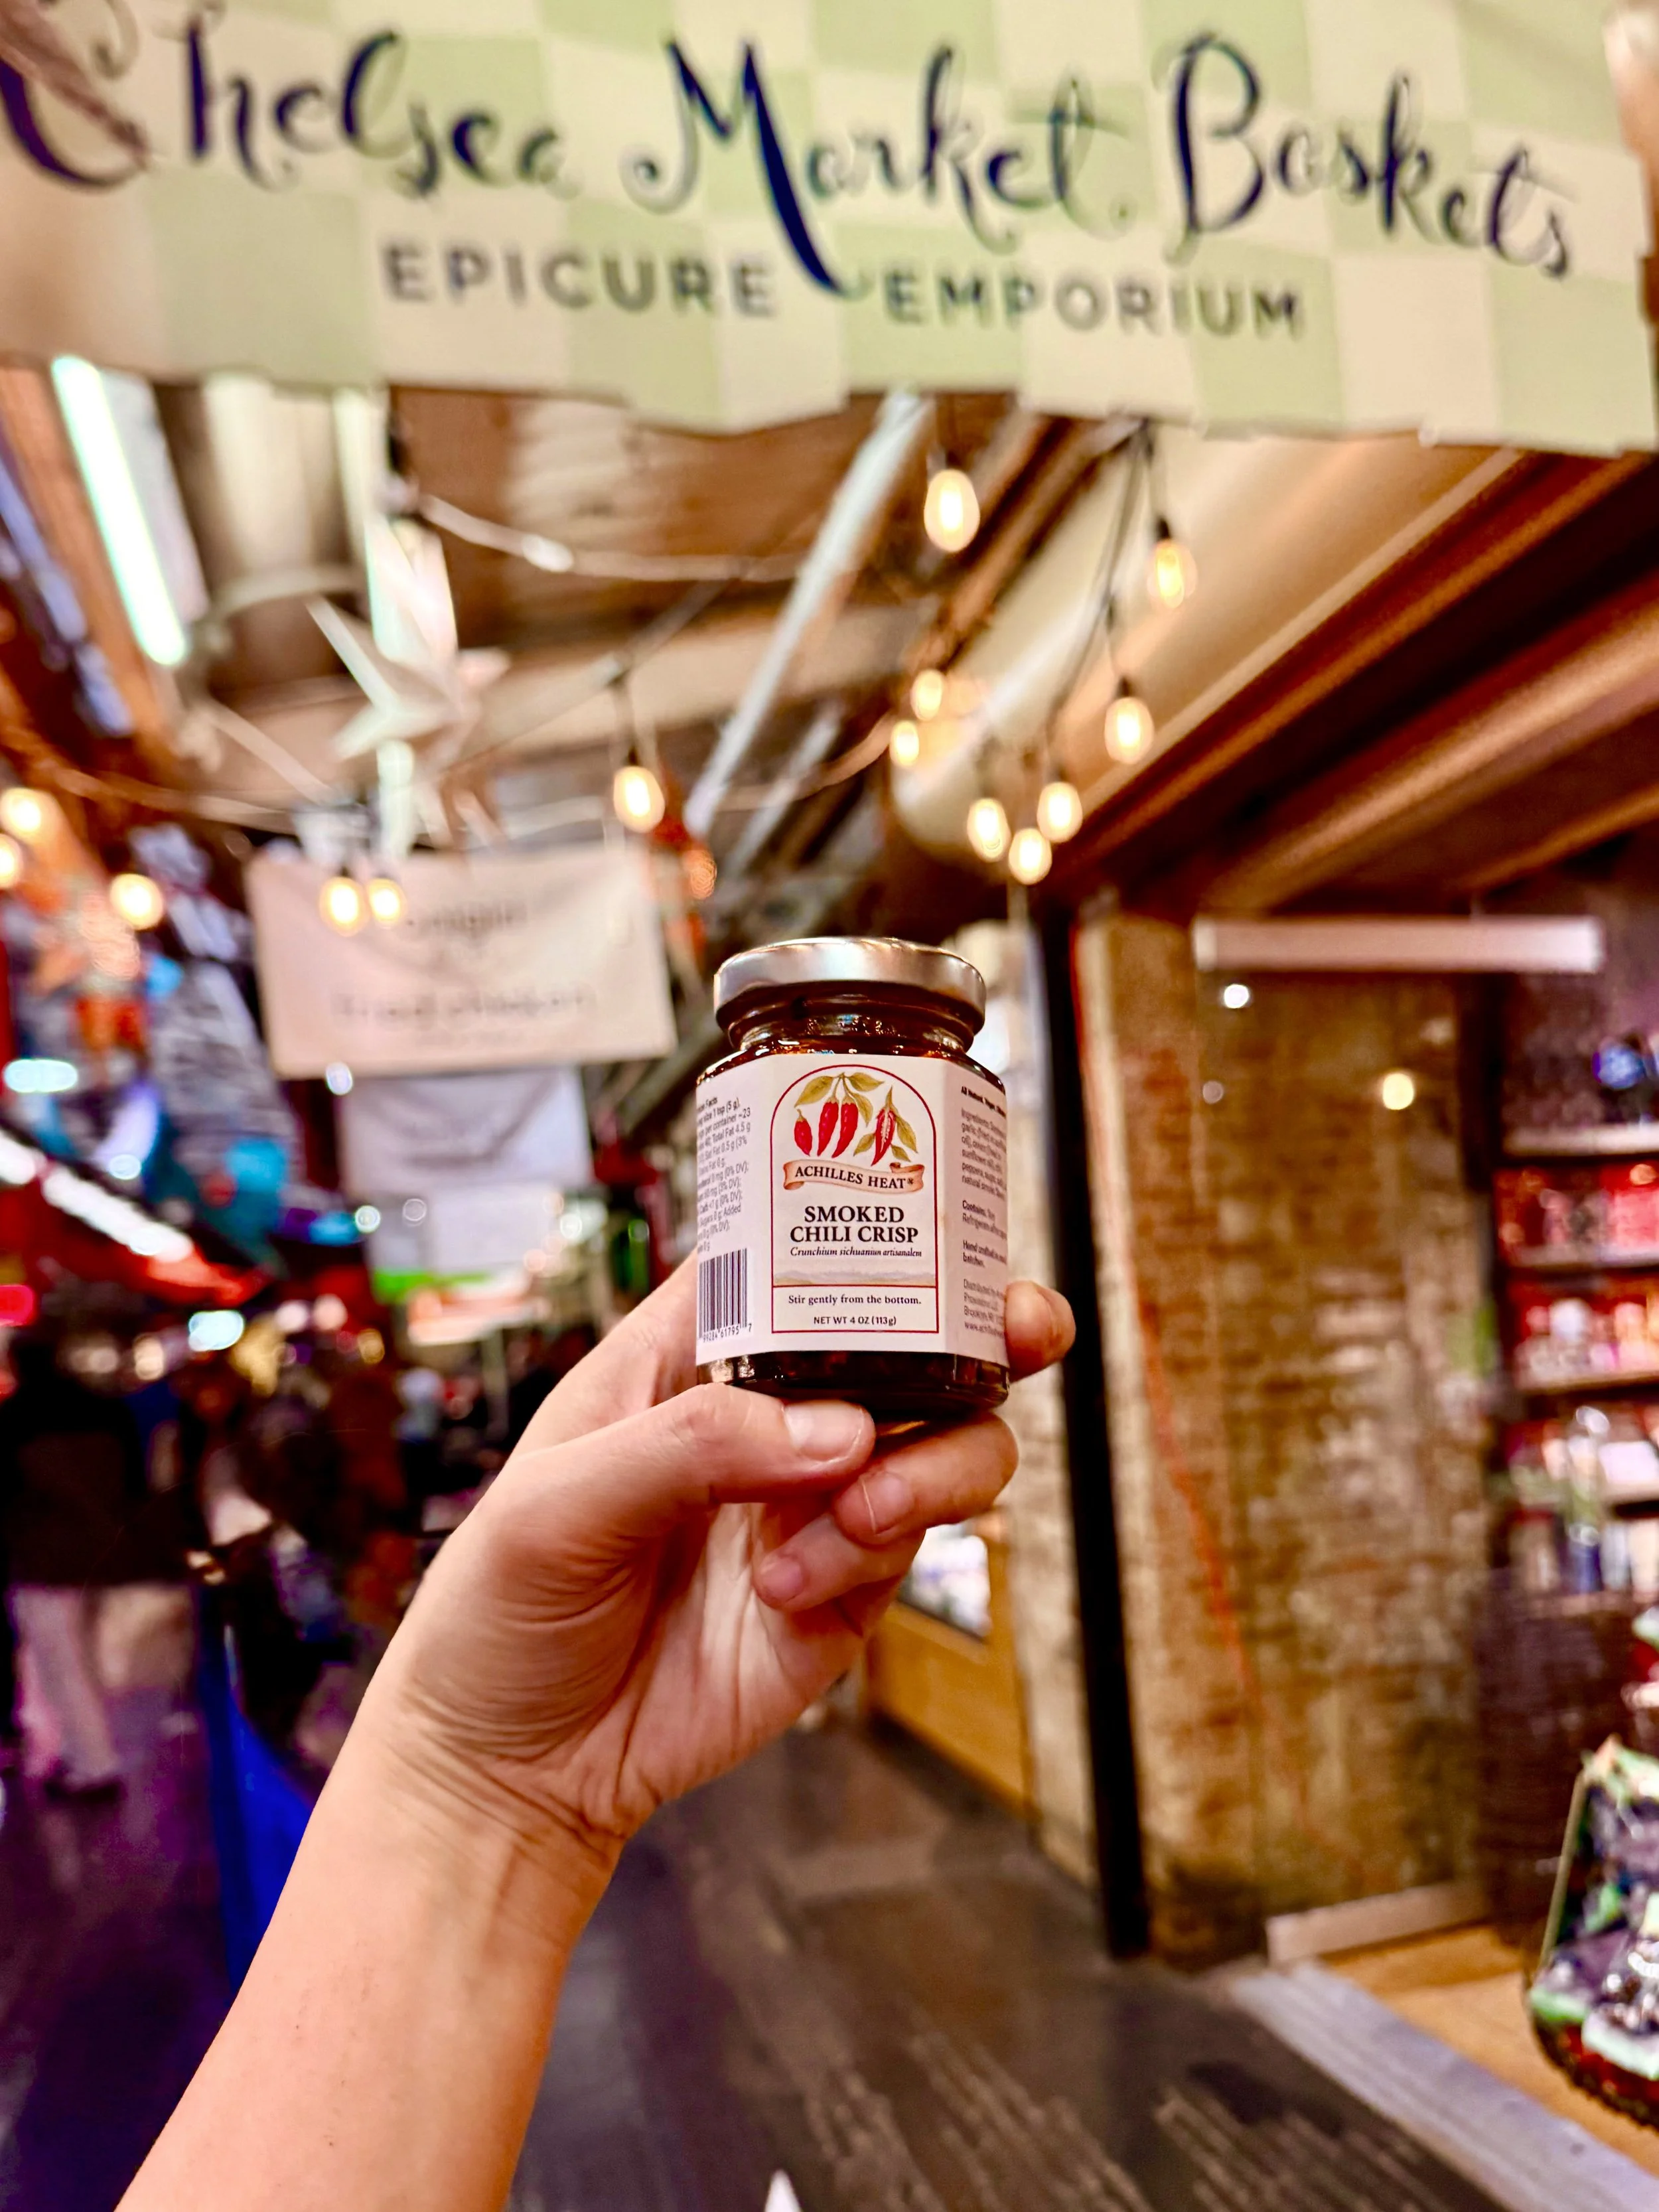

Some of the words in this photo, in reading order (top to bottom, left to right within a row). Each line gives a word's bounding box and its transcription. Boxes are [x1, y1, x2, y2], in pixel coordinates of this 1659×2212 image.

[622, 33, 1130, 298] Market
[1153, 31, 1579, 277] Baskets
[381, 237, 780, 319] EPICURE
[884, 265, 1305, 340] EMPORIUM
[795, 1165, 863, 1185] ACHILLES
[804, 1205, 904, 1223] SMOKED
[790, 1226, 851, 1243] CHILI
[857, 1226, 918, 1244] CRISP
[790, 1246, 837, 1256] Crunchium
[788, 1295, 805, 1304] Stir
[808, 1294, 838, 1305] gently
[841, 1294, 863, 1304] from
[867, 1295, 882, 1304] the
[885, 1295, 922, 1305] bottom.
[814, 1316, 831, 1325] NET
[833, 1316, 847, 1325] WT
